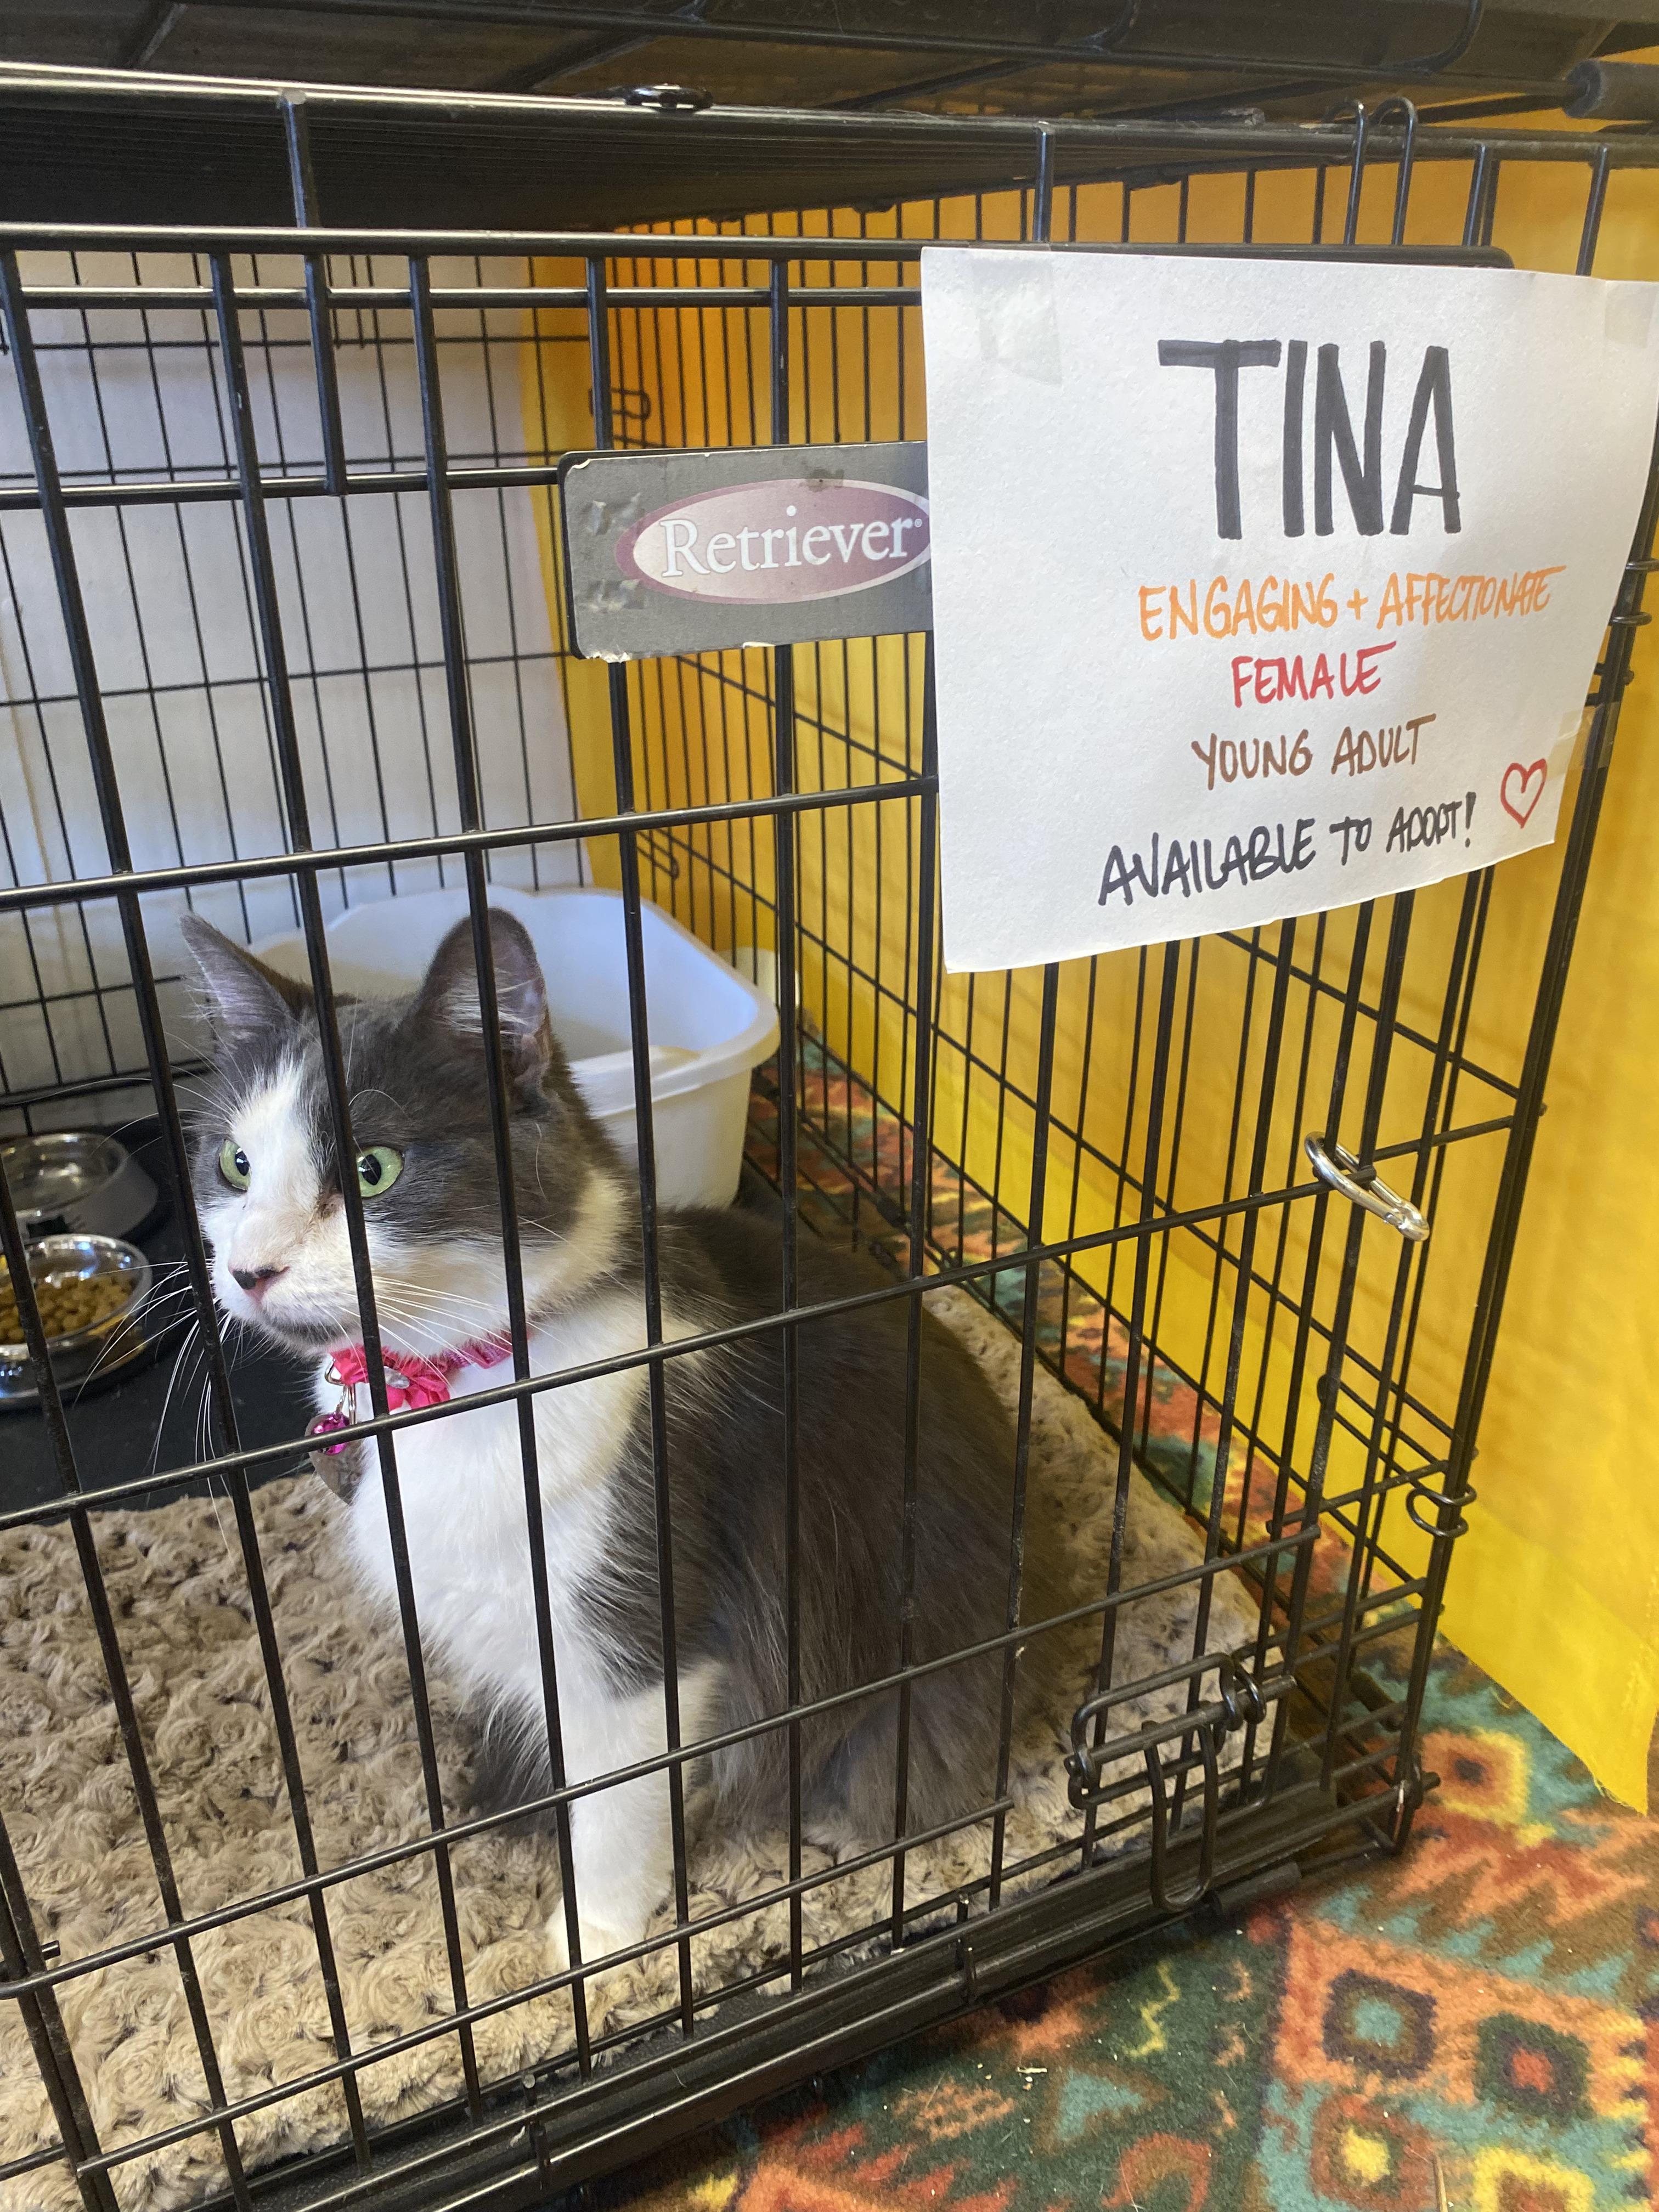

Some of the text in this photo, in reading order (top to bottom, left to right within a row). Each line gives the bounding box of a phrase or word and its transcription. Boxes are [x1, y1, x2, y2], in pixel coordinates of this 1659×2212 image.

[1158, 338, 1461, 540] TINA
[1139, 565, 1566, 640] ENGAGING + AFFECTIONATE
[1231, 642, 1396, 708] FEMALE
[1192, 714, 1436, 790] YOUNG ADULT
[1098, 792, 1476, 905] AVAILABLE TO ADOPT!
